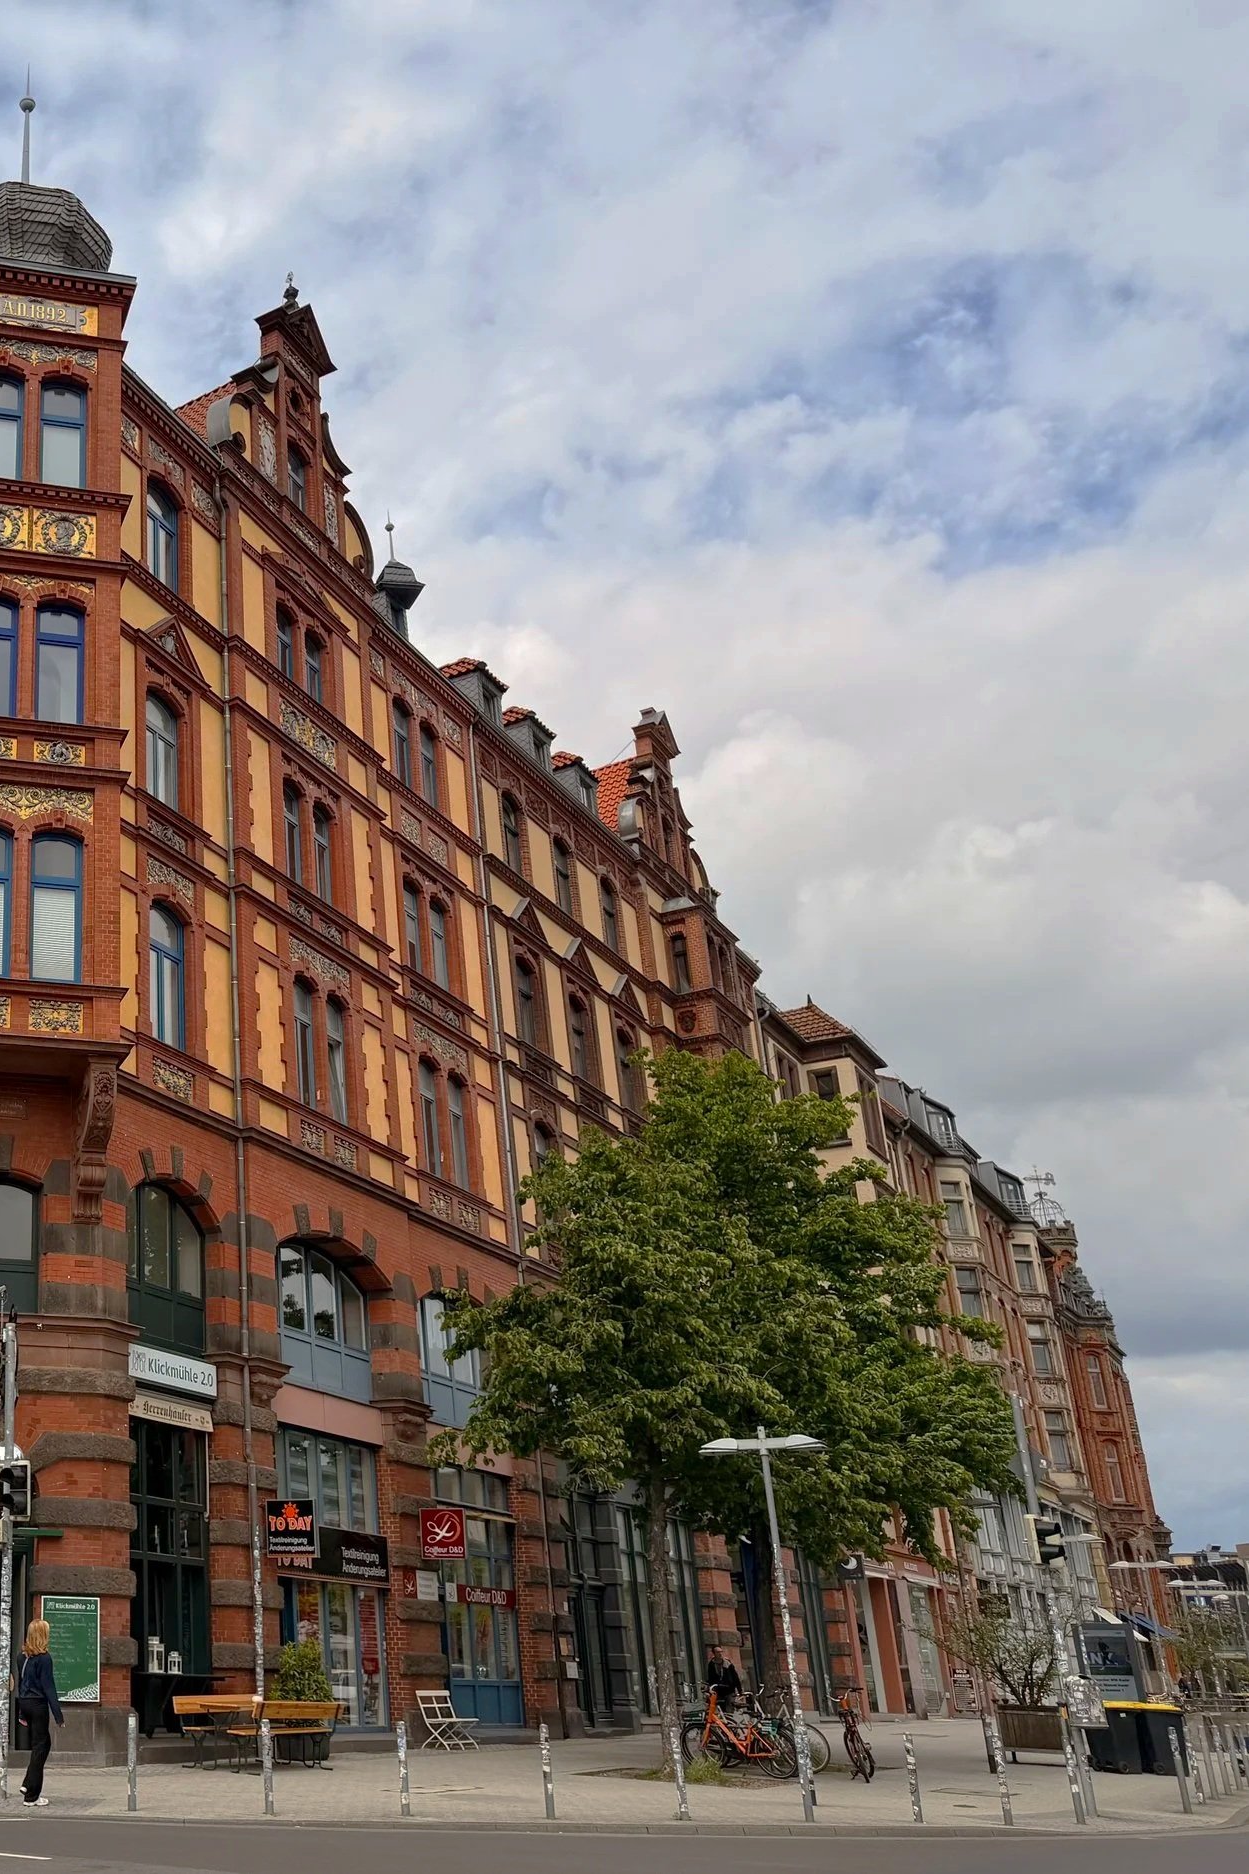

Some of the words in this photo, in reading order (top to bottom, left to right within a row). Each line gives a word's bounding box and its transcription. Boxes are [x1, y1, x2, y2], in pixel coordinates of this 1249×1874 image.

[148, 1358, 199, 1384] Klickmühle
[201, 1371, 214, 1387] 2.0
[269, 1536, 308, 1545] Textilreinigung
[341, 1546, 380, 1565] Textilreinigung
[448, 1546, 464, 1554] D&D
[465, 1587, 490, 1603] Coiffeur
[491, 1590, 507, 1605] D&D
[55, 1602, 86, 1610] Klickmühle
